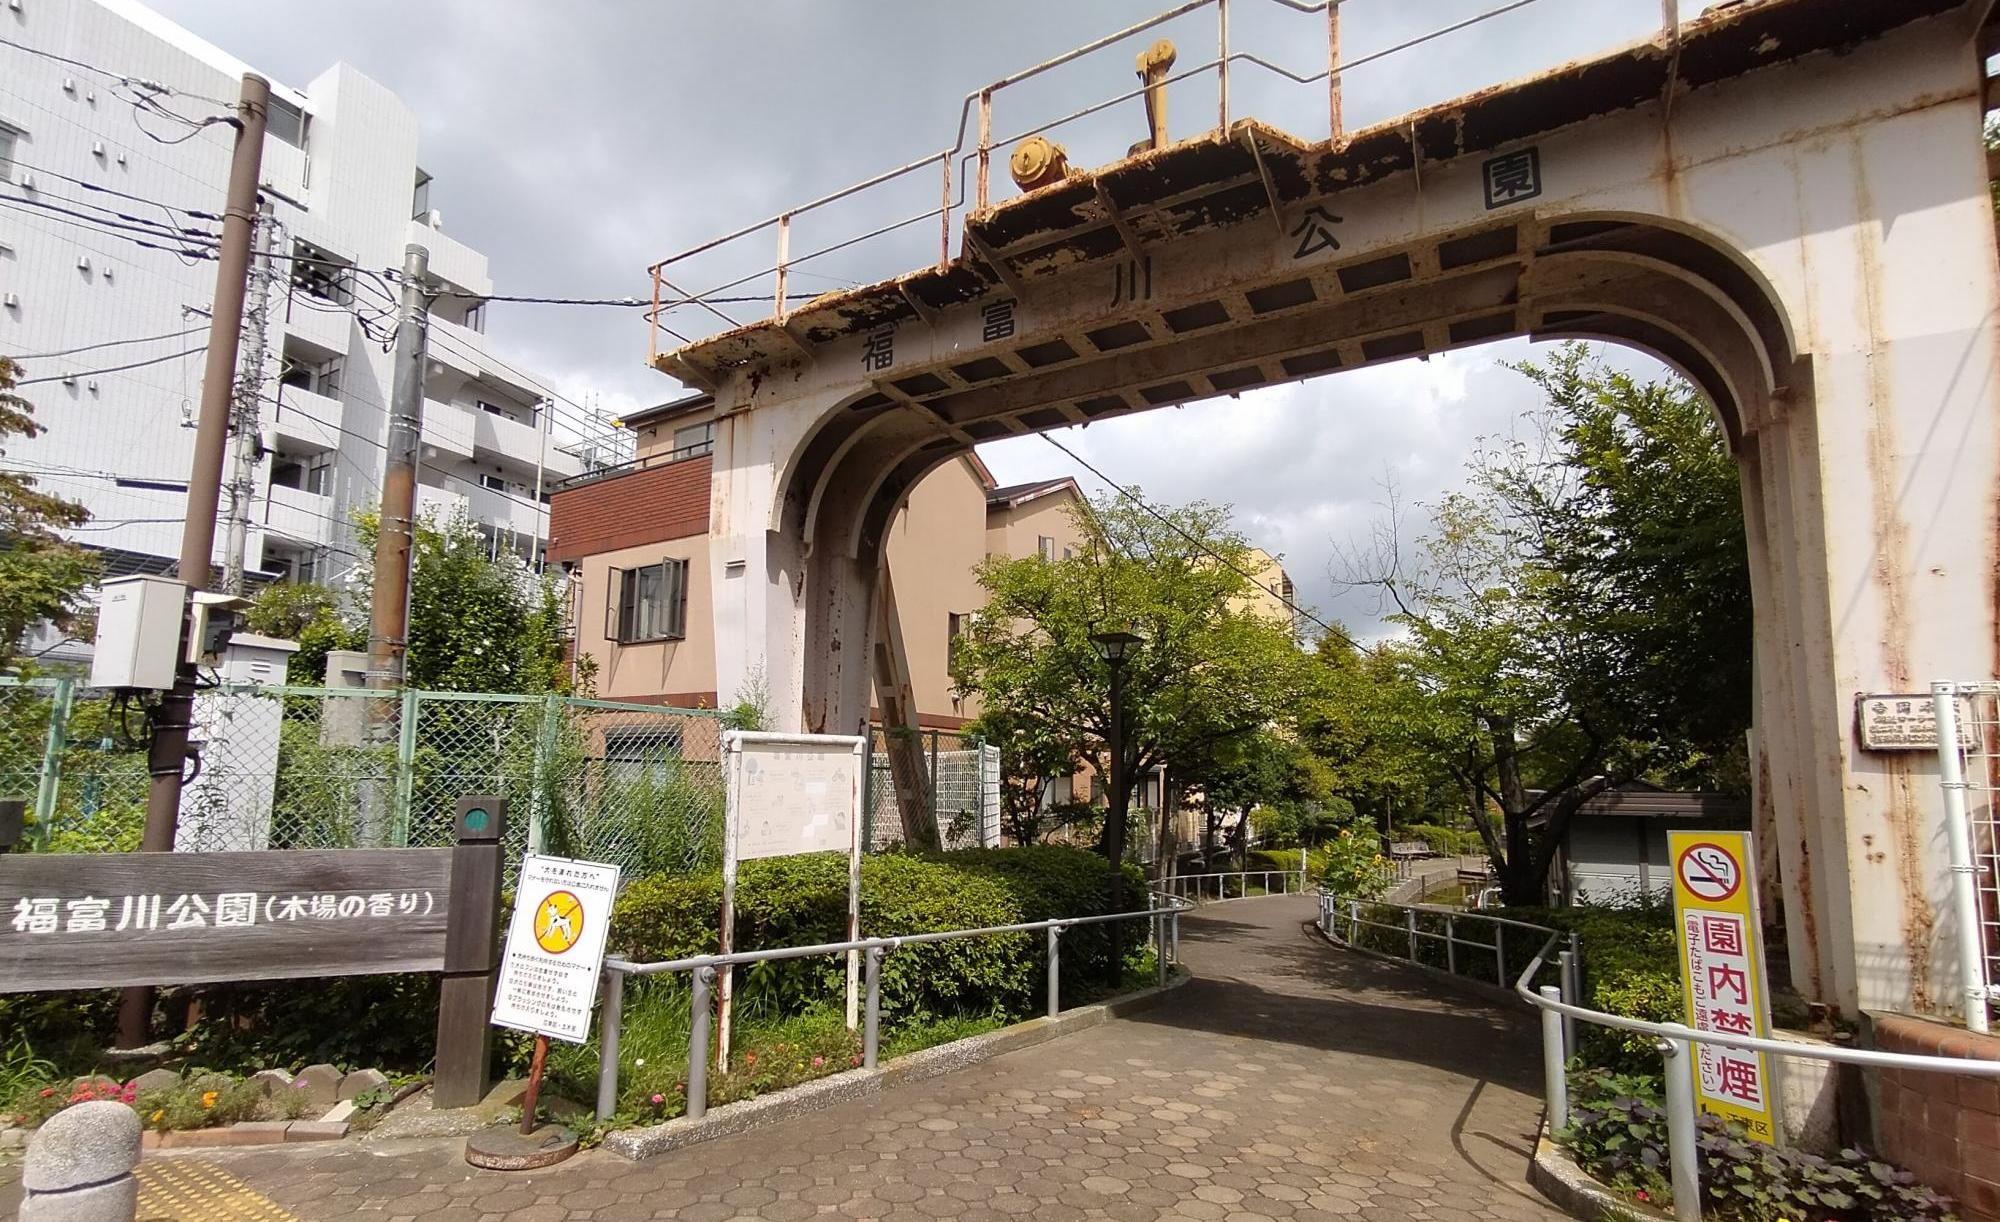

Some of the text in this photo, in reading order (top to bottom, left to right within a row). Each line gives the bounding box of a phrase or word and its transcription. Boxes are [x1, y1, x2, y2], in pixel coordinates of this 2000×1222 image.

[861, 147, 1542, 371] 福富川公園
[11, 890, 434, 934] 福富川公園（木場の香り）
[1702, 915, 1760, 1104] 園内禁煙
